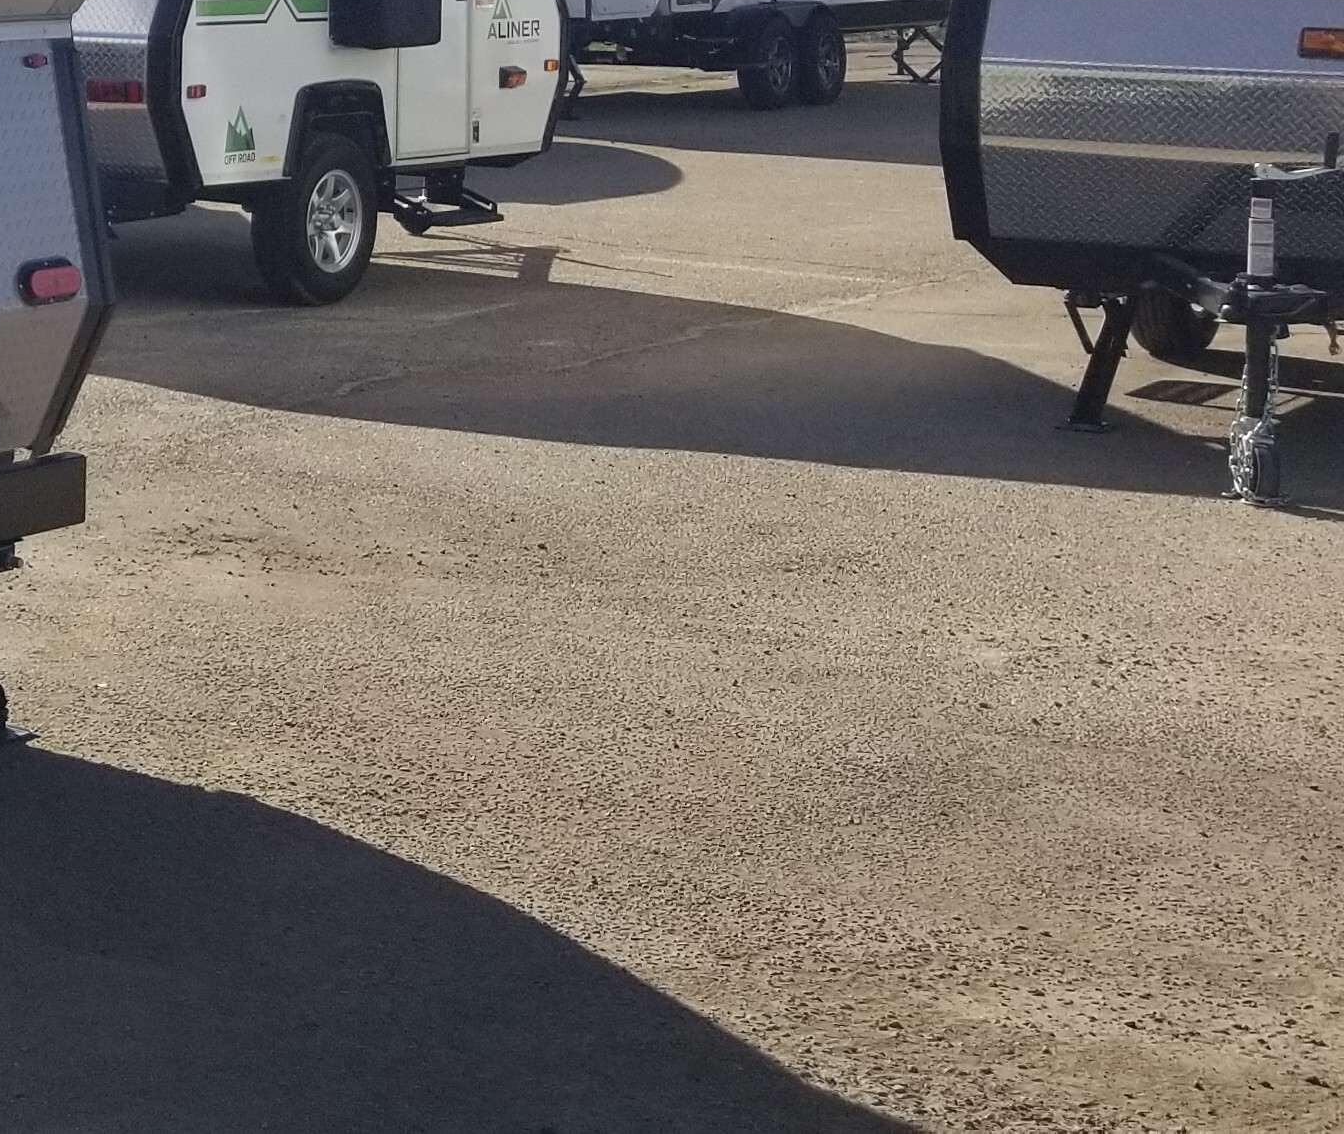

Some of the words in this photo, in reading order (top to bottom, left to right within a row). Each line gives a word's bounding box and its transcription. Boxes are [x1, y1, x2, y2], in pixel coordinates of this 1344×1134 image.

[487, 19, 540, 40] ALINER
[224, 154, 237, 165] OFF
[238, 152, 256, 164] ROAD
